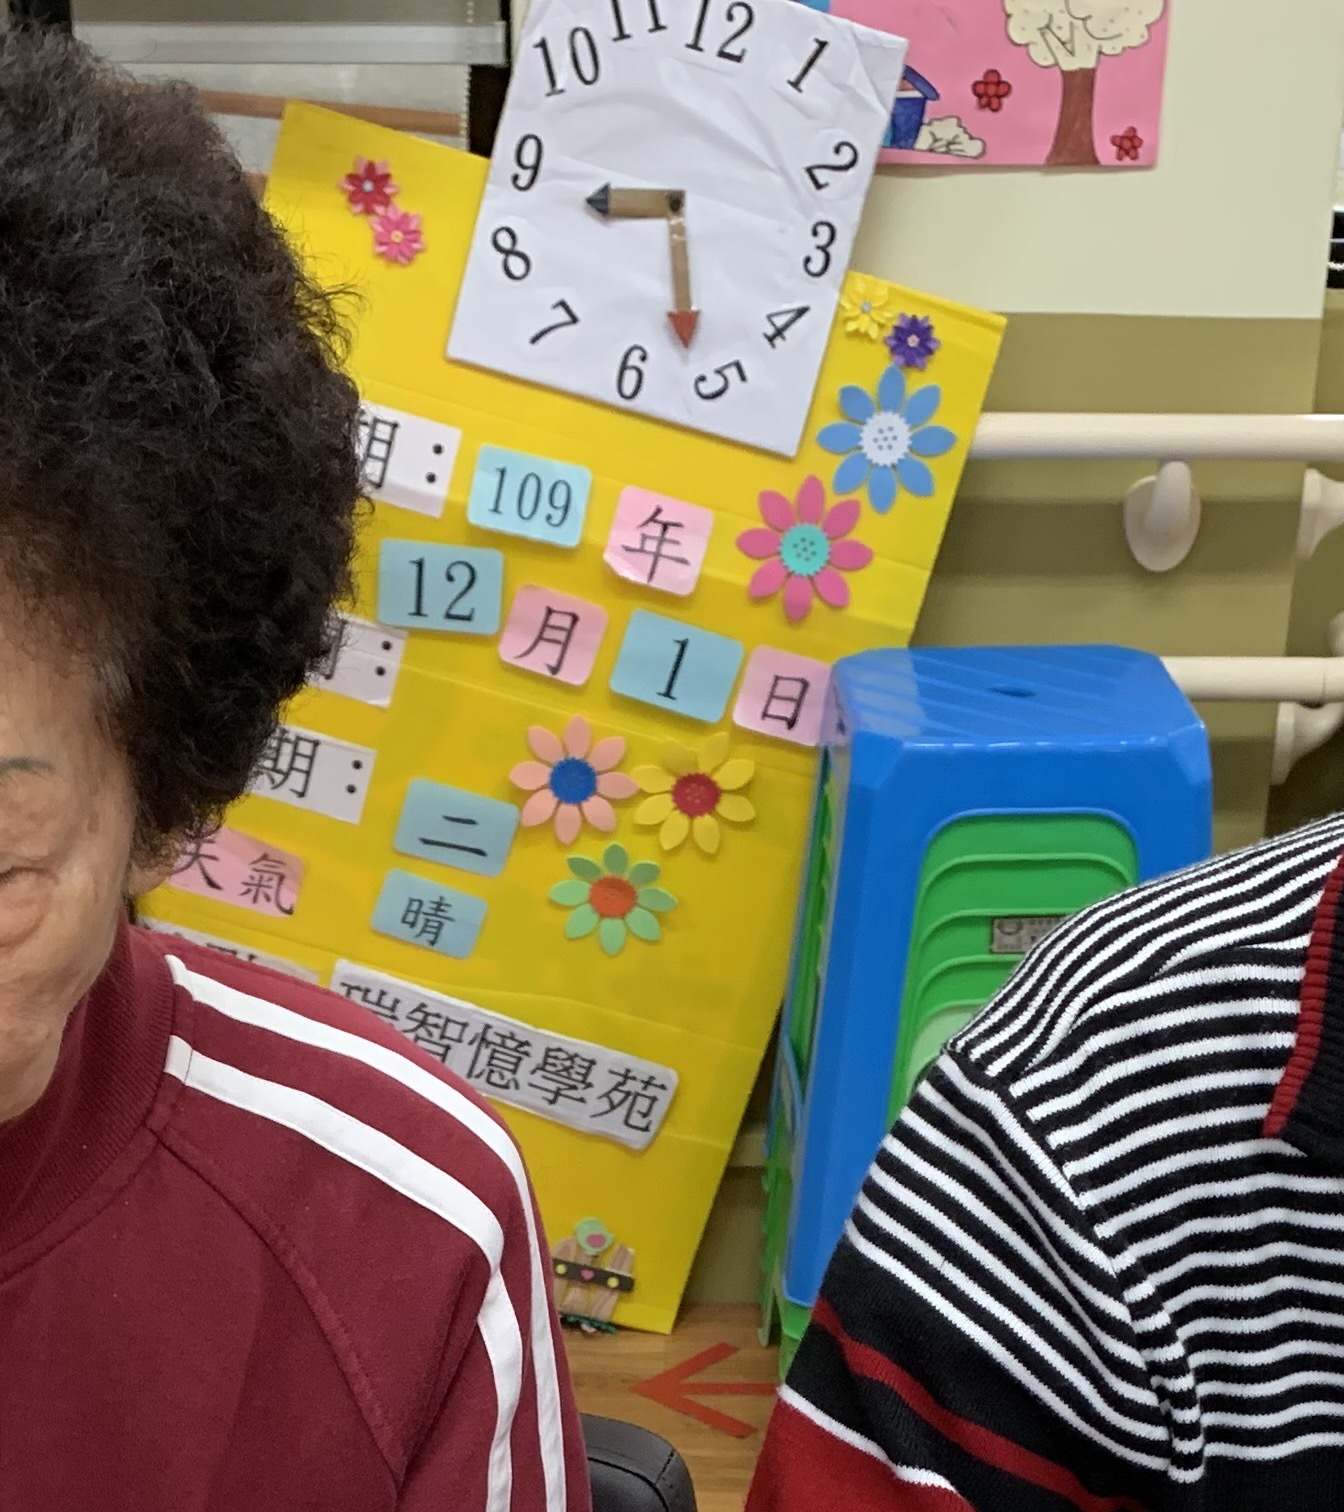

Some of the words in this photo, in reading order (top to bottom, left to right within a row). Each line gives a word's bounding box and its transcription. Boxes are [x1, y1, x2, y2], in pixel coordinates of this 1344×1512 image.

[684, 0, 754, 63] 12
[532, 26, 600, 98] 10
[786, 37, 829, 93] 1
[511, 133, 544, 191] 9
[804, 141, 860, 191] 2
[491, 226, 532, 281] 8
[803, 220, 838, 277] 3
[528, 298, 580, 346] 7
[763, 303, 811, 349] 4
[616, 344, 648, 400] 6
[693, 358, 748, 401] 5
[487, 464, 574, 528] 109
[620, 505, 690, 584] 年
[406, 556, 479, 624] 12
[514, 605, 580, 678] 月
[655, 636, 691, 702] 1
[758, 672, 810, 731] 日
[418, 814, 488, 858] 二
[399, 893, 456, 948] 晴
